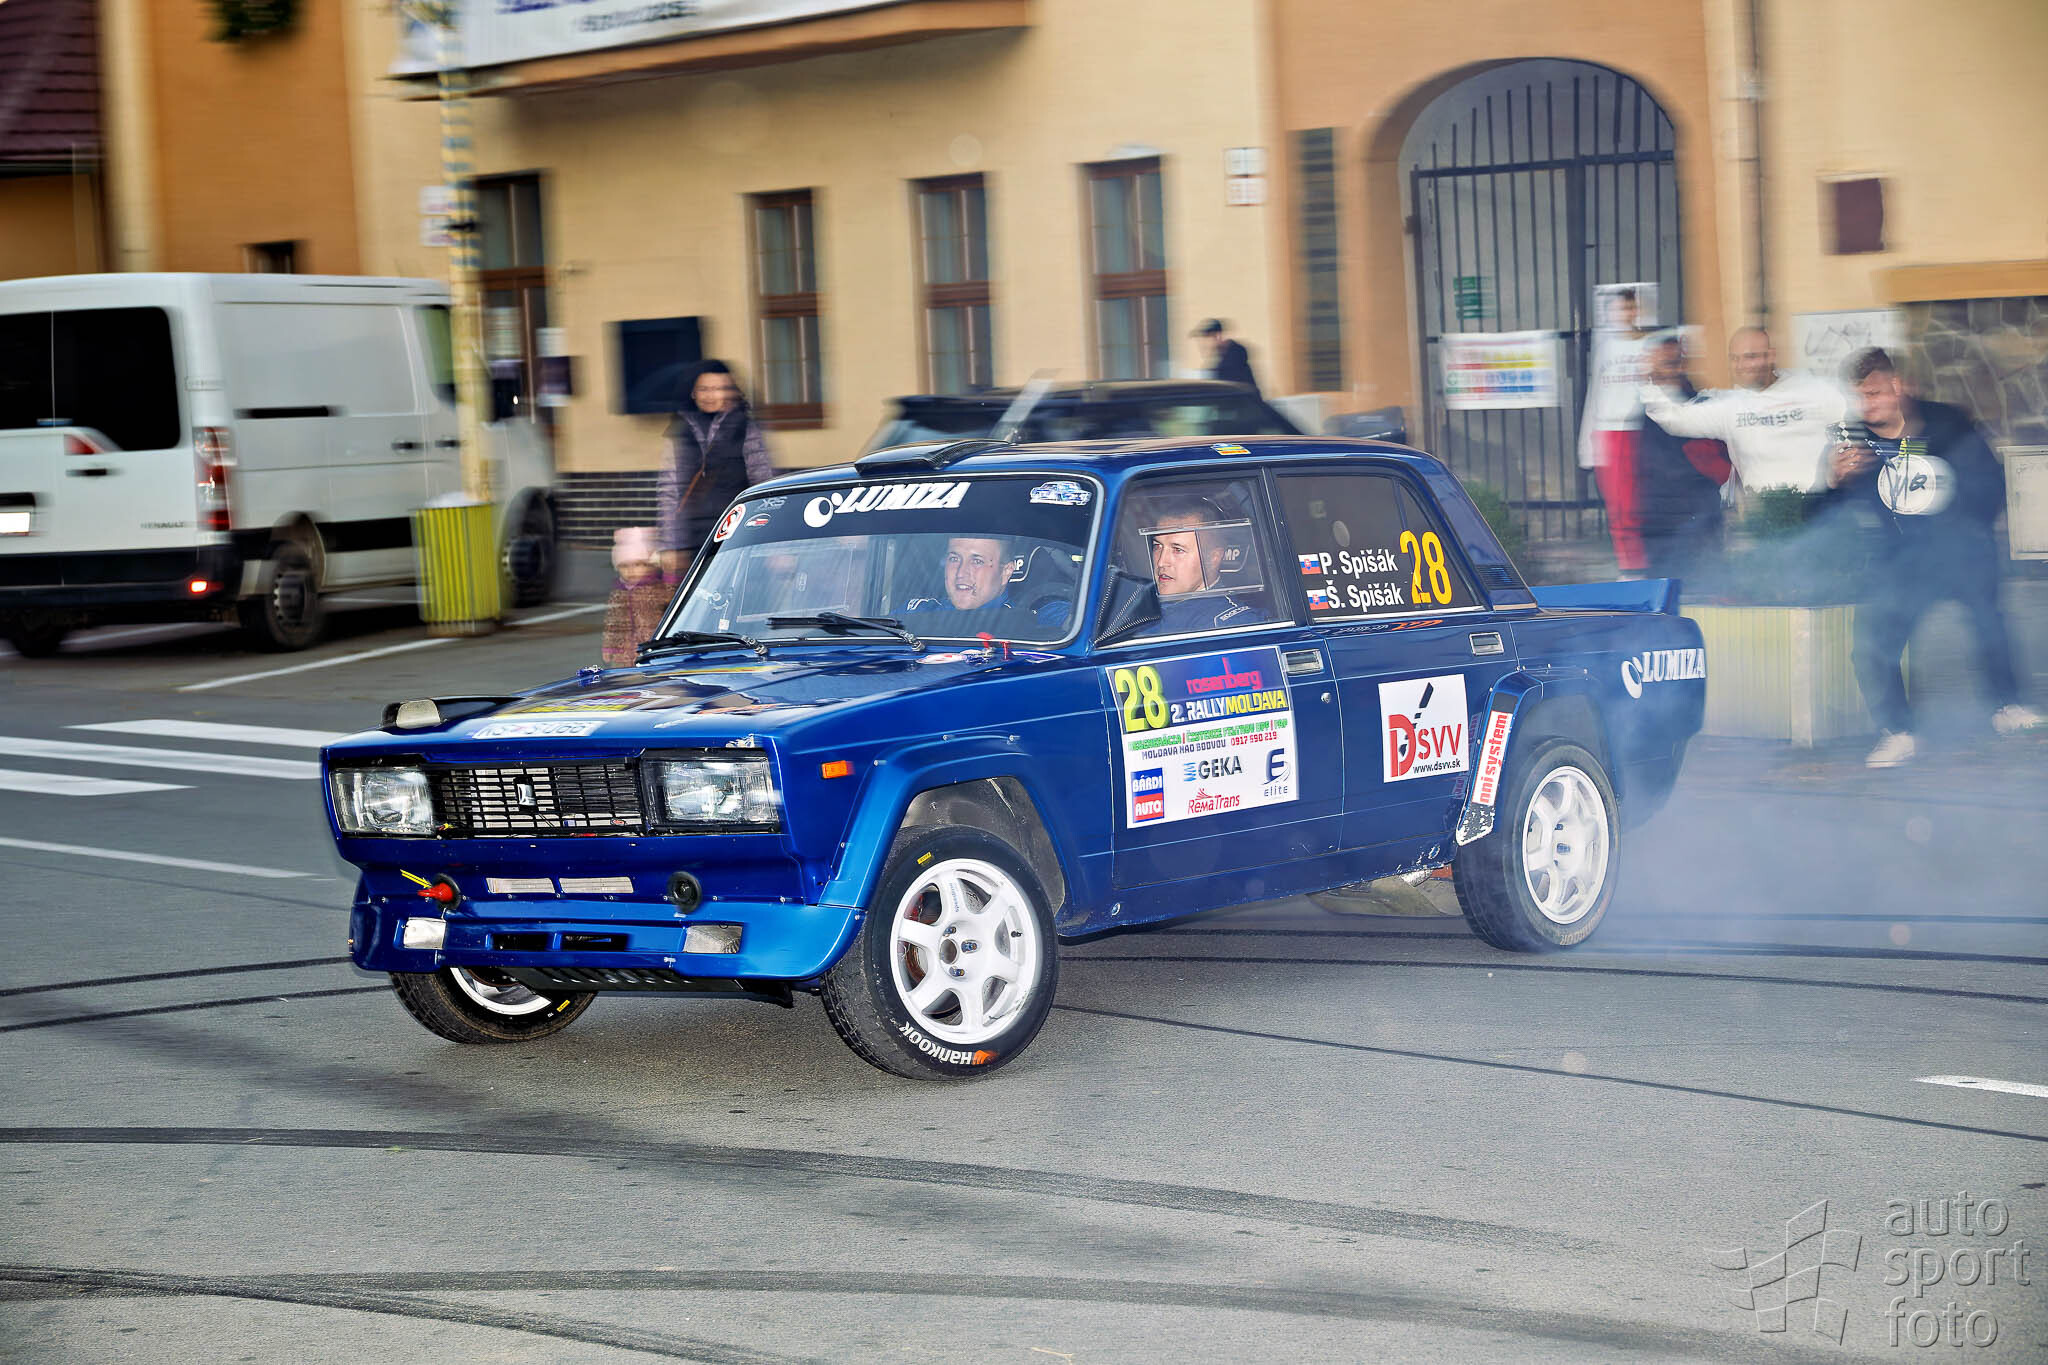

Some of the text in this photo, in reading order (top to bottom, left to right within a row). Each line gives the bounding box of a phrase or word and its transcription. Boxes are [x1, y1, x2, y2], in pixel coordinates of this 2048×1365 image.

[833, 482, 971, 514] LUMIZA
[1319, 549, 1398, 579] P. Spišák
[1400, 530, 1453, 605] 28
[1326, 580, 1405, 612] Š. Spišák
[1186, 657, 1263, 695] rosenberg
[1642, 648, 1706, 683] LUMIZA
[1114, 666, 1168, 731] 28
[1170, 704, 1186, 723] 2.
[1142, 746, 1178, 760] MOLDAVA
[1179, 744, 1195, 755] NAD
[1196, 739, 1226, 752] BODVOU
[1231, 735, 1249, 746] 0917
[1264, 731, 1277, 742] 219
[1199, 755, 1242, 780] GEKA
[1413, 758, 1461, 774] www.dsvv.sk
[1132, 775, 1162, 792] BÁRDI
[1135, 799, 1162, 817] AUTO
